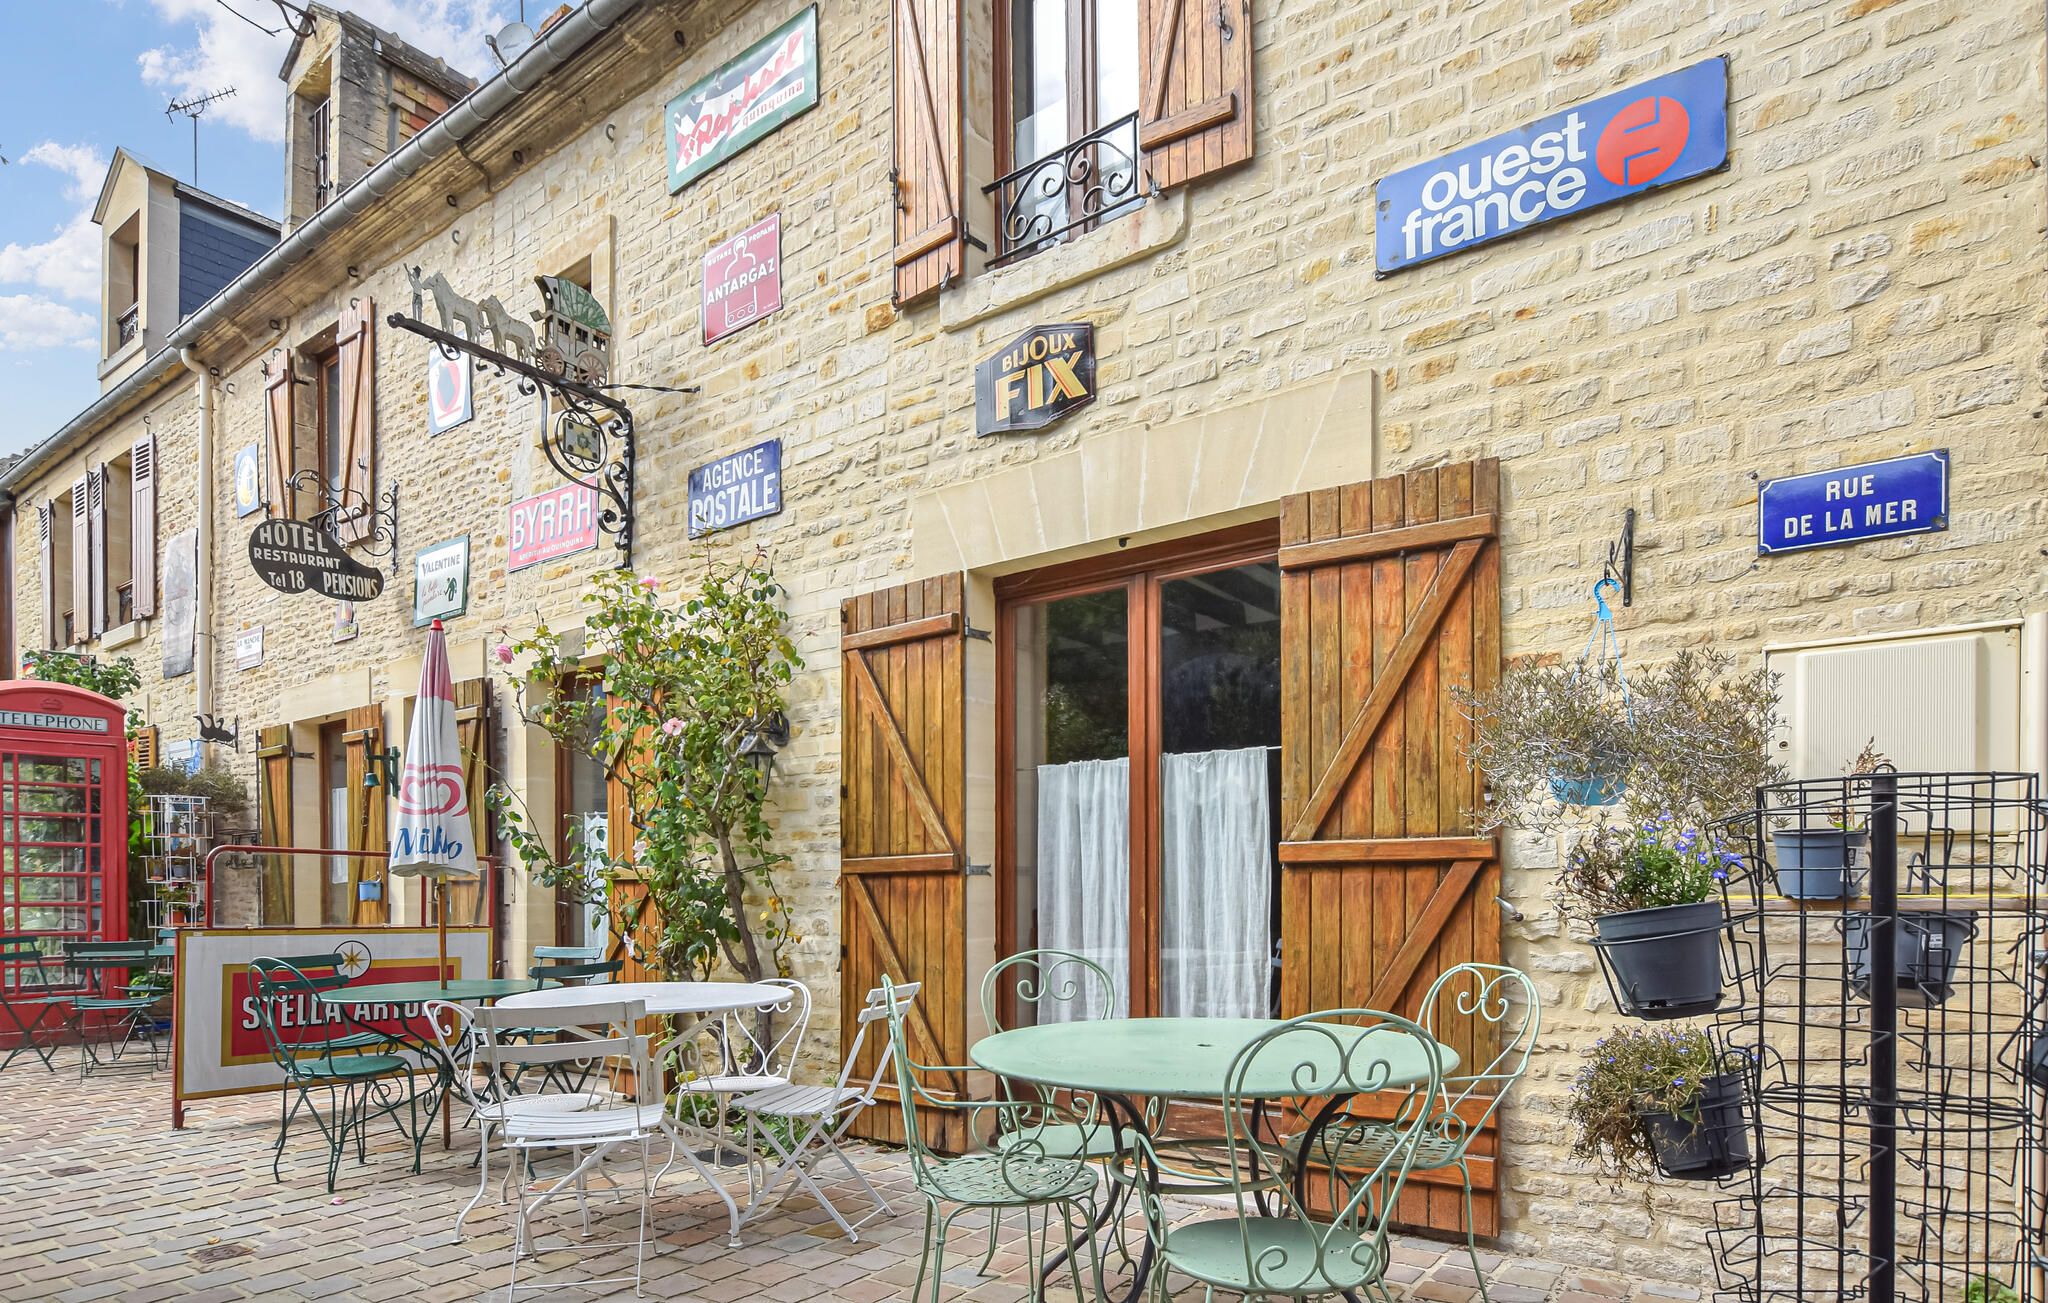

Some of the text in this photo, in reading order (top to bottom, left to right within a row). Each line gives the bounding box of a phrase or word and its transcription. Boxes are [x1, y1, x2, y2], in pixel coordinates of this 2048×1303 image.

[742, 80, 803, 127] quinquina
[1421, 112, 1587, 212] ouest
[1401, 166, 1587, 260] france
[706, 257, 775, 306] ANTARGAZ
[1002, 333, 1077, 373] BIJOUX
[995, 351, 1088, 422] FIX
[702, 448, 764, 493] AGENCE
[1826, 474, 1875, 501] RUE
[512, 488, 593, 551] BYRRH
[691, 472, 776, 534] POSTALE
[1784, 499, 1917, 539] DE LA MER
[259, 520, 329, 554] HÔTEL
[253, 547, 341, 570] RESTAURANT
[421, 554, 461, 577] VALENTINE
[288, 570, 306, 590] 18
[322, 571, 379, 599] PENSIONS
[0, 712, 104, 731] TELEPHONE
